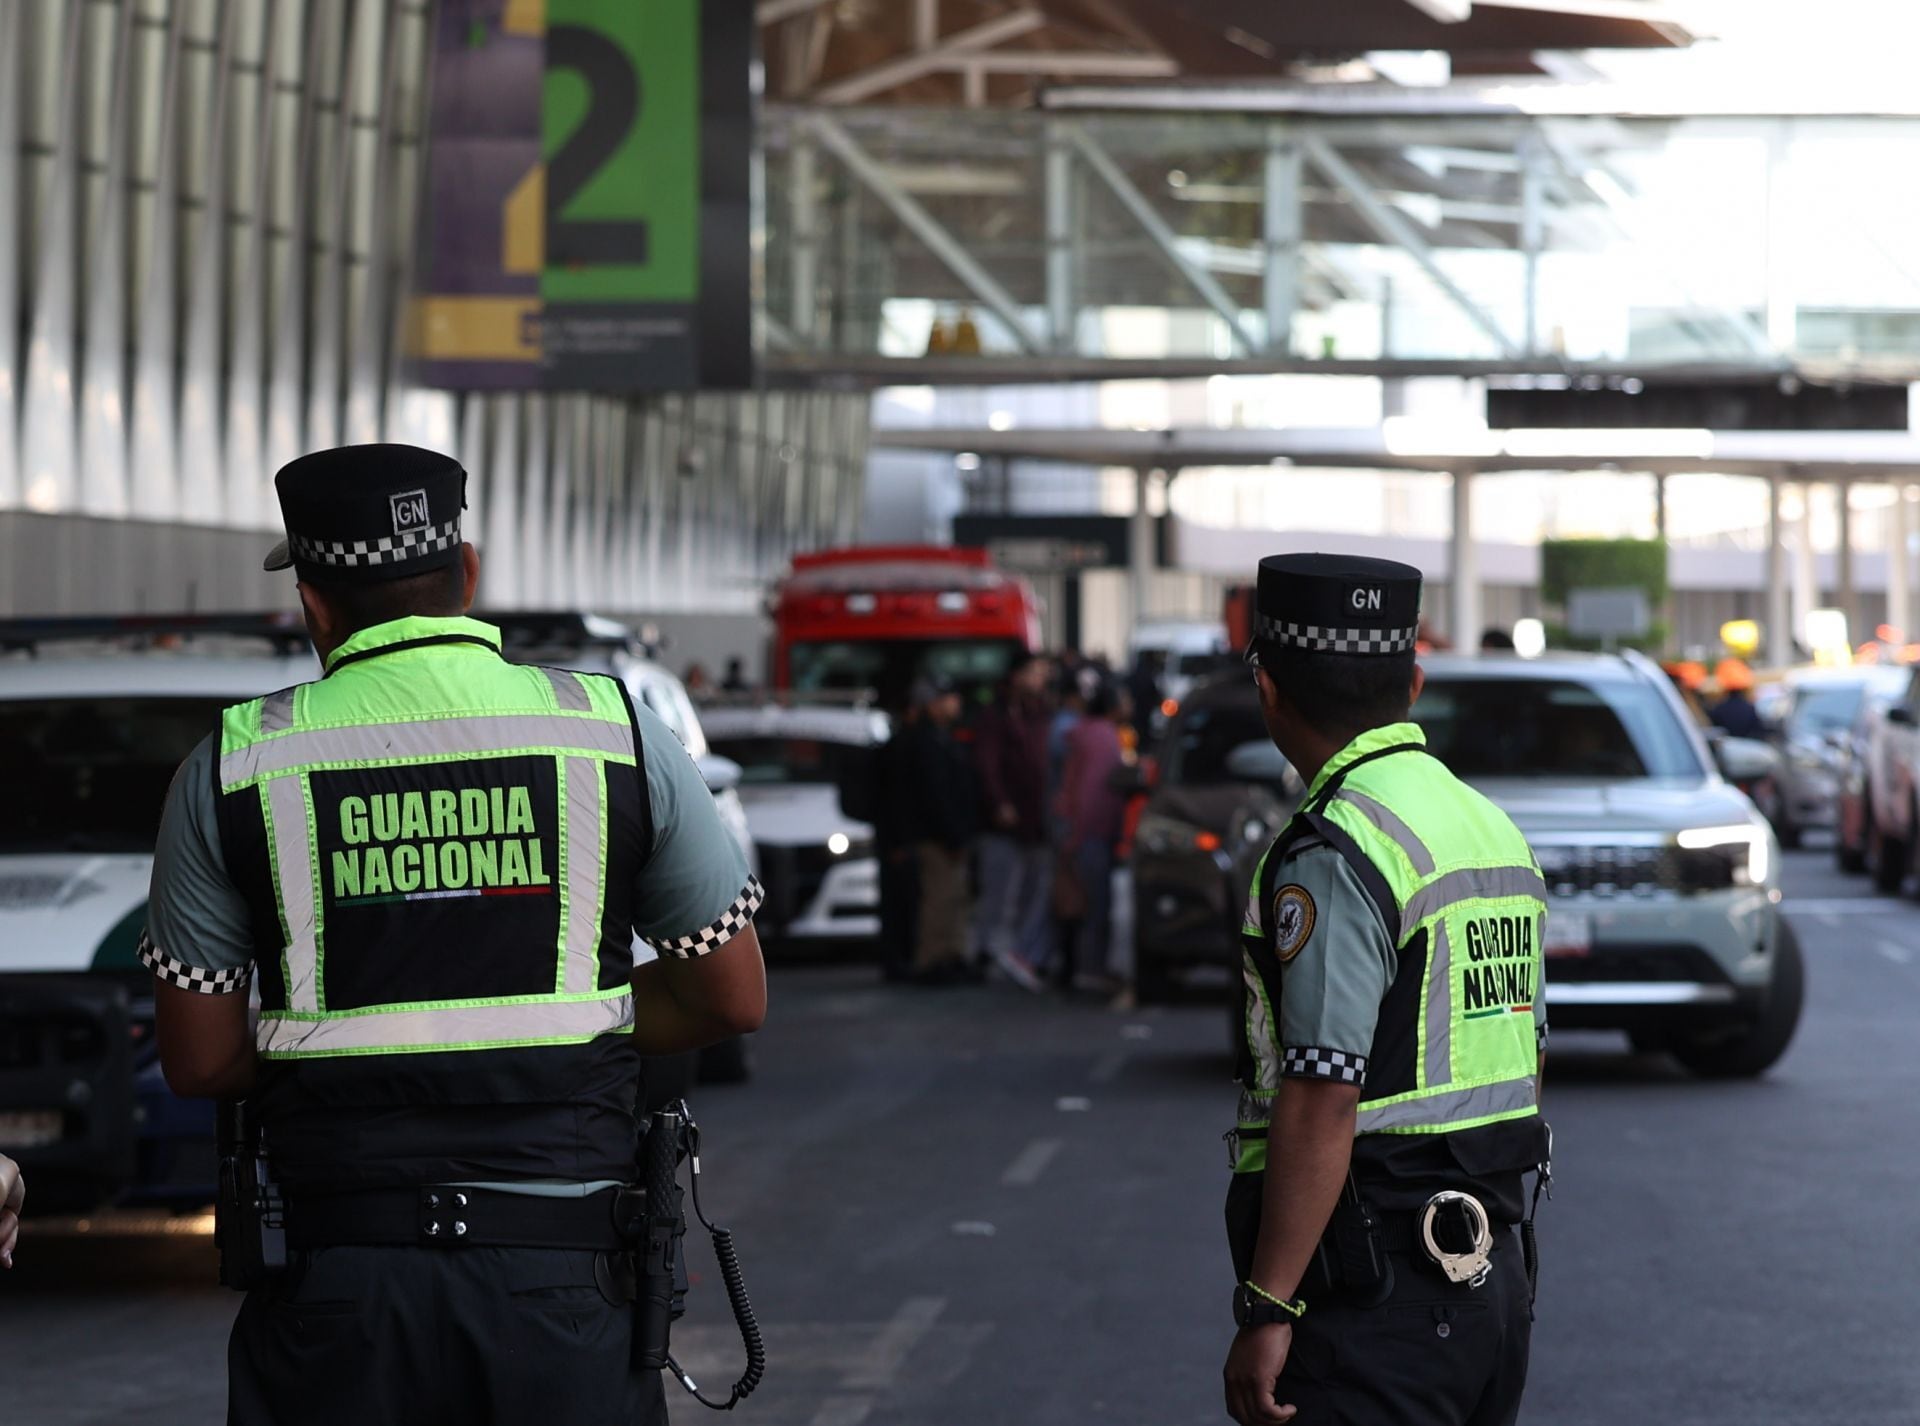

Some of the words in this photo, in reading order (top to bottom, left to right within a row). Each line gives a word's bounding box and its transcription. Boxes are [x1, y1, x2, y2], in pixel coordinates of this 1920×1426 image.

[506, 22, 648, 272] 2
[396, 499, 425, 526] GN
[1352, 588, 1381, 610] GN
[339, 786, 535, 845] GUARDIA
[332, 838, 550, 897] NACIONAL
[1465, 916, 1532, 963] GURDIA
[1463, 962, 1532, 1011] NAONAL
